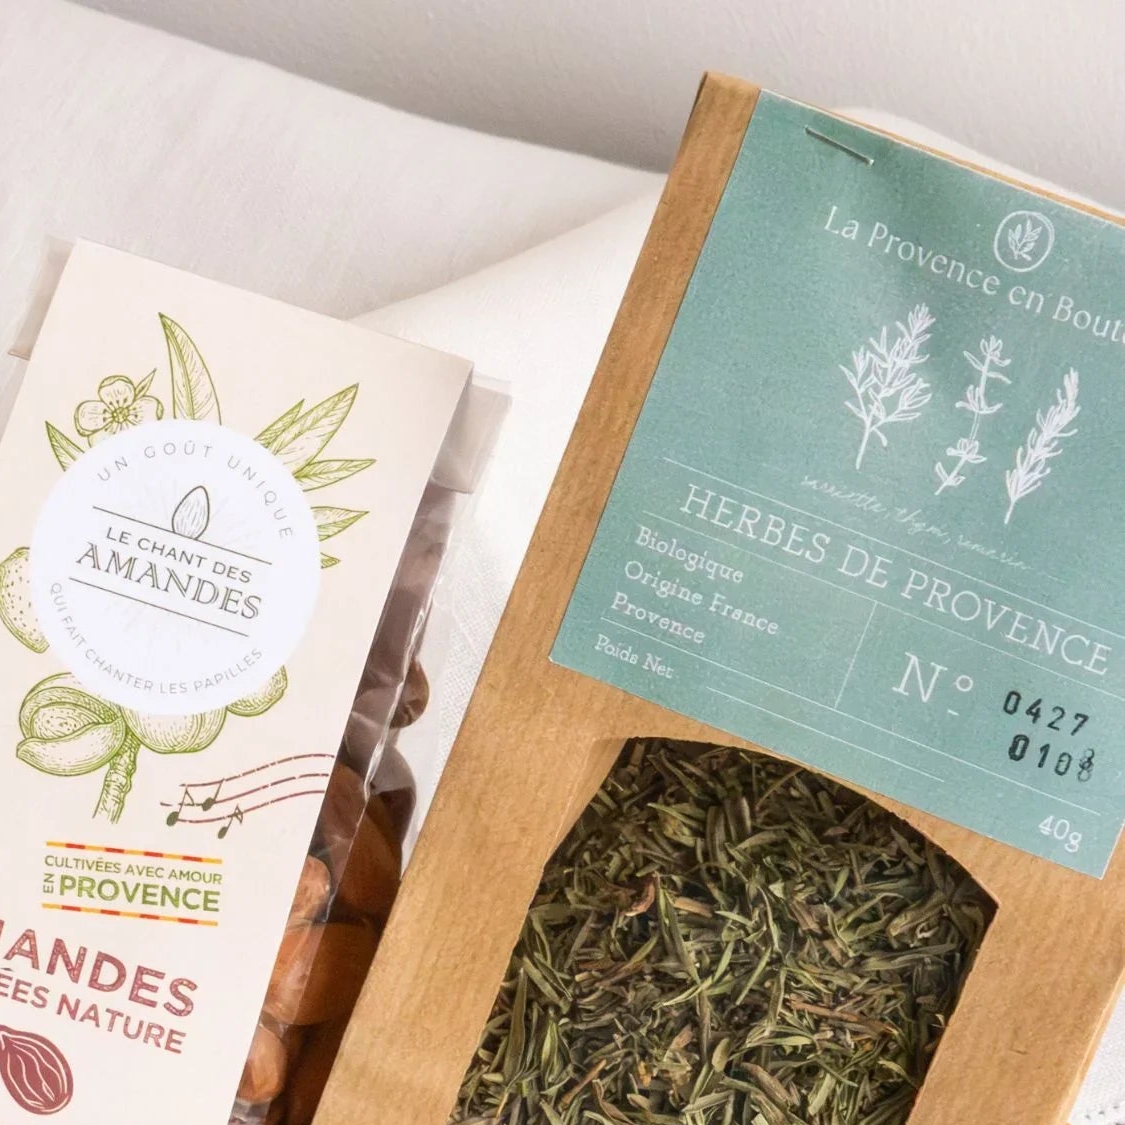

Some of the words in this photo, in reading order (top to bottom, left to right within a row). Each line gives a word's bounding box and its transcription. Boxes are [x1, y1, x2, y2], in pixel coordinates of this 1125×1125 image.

[823, 205, 858, 242] La
[867, 221, 1000, 296] Provence
[1008, 285, 1045, 314] en
[1052, 295, 1125, 345] Bout
[97, 455, 129, 482] UN
[143, 438, 214, 460] GOÛT
[226, 455, 294, 540] UNIQUE
[75, 541, 263, 621] AMANDES
[105, 525, 131, 546] LE
[137, 536, 207, 569] CHANT
[211, 560, 253, 584] DES
[634, 524, 745, 583] Biologique
[679, 483, 832, 563] HERBES
[836, 543, 893, 589] DE
[900, 567, 1114, 675] PROVENCE
[610, 591, 706, 644] Provence
[624, 560, 704, 605] Origine
[708, 593, 779, 635] France
[49, 582, 66, 614] QUI
[63, 615, 87, 648] FAIT
[83, 647, 155, 692] CHANTER
[159, 681, 188, 695] LES
[193, 647, 263, 693] PAPILLES
[594, 633, 638, 665] Poids
[1002, 690, 1089, 737] 0427
[1037, 814, 1083, 853] 40g
[42, 873, 55, 895] EN
[58, 873, 221, 913] PROVENCE
[43, 854, 122, 875] CULTIVÉES
[124, 863, 165, 879] AVEC
[167, 868, 223, 886] AMOUR
[55, 992, 188, 1055] NATURE
